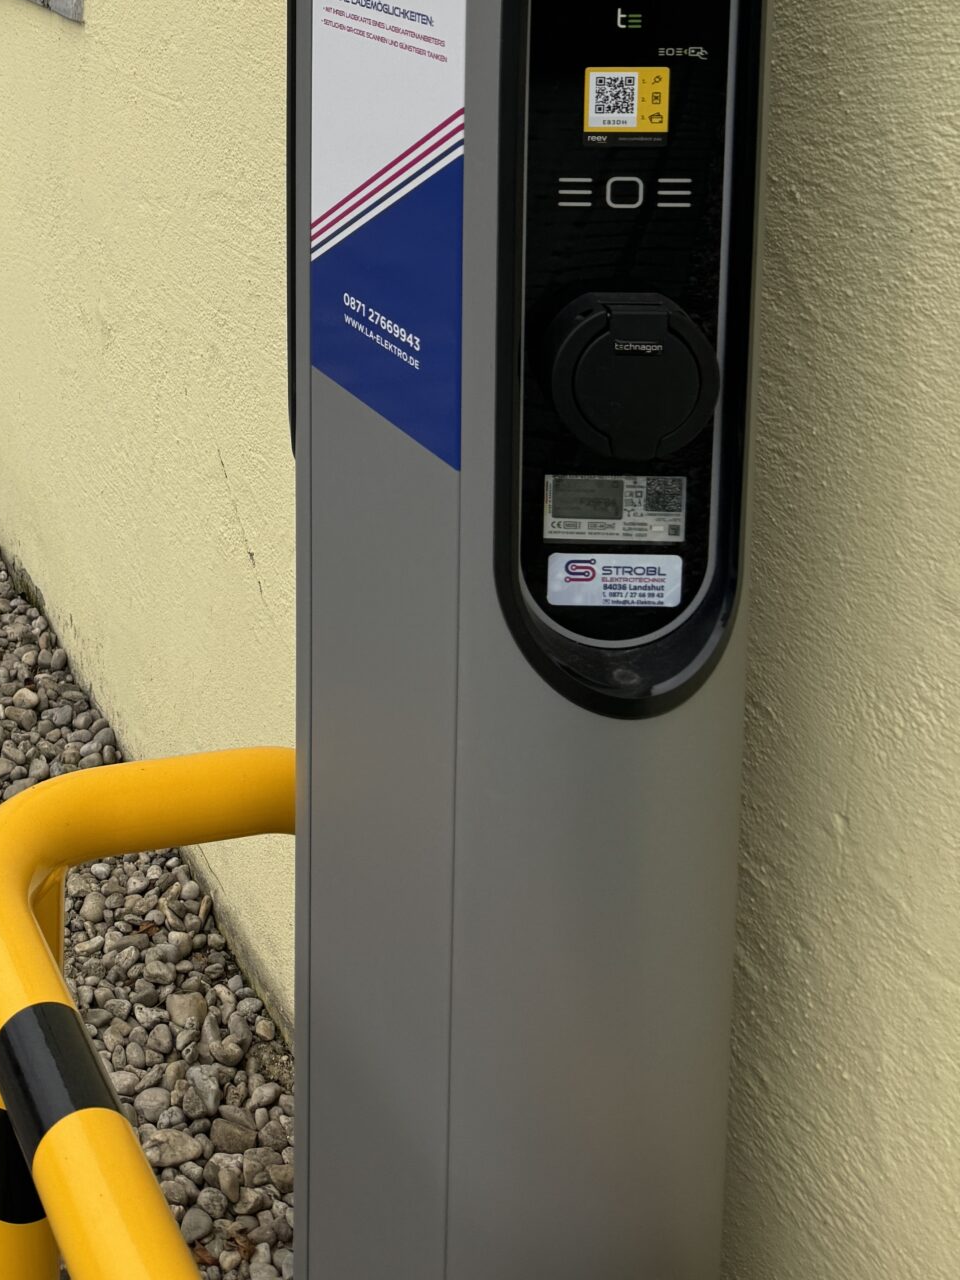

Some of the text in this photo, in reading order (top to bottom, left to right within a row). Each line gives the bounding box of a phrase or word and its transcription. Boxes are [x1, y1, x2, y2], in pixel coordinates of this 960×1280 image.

[343, 292, 421, 351] 0871 27669943
[344, 313, 420, 370] WWW.LA-ELEKTRO.DE
[614, 342, 663, 353] technagon
[601, 566, 667, 576] STROBL
[629, 583, 664, 591] Landshut
